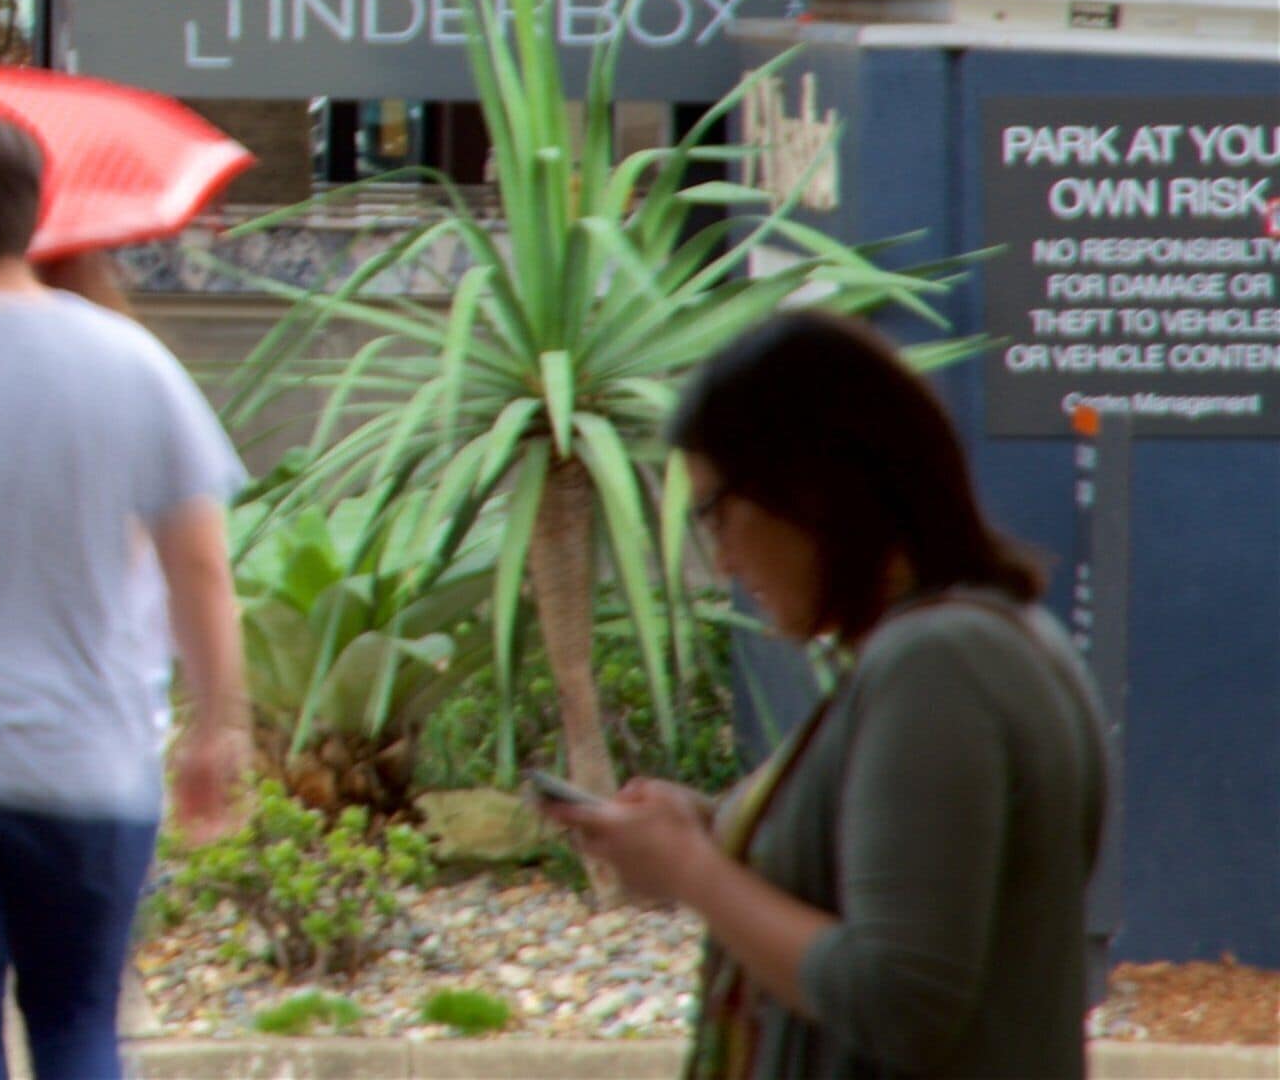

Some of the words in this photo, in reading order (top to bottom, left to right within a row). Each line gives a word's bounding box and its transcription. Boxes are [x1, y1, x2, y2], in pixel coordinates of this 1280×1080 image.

[1002, 126, 1122, 165] PARK
[1126, 126, 1181, 165] AT
[1048, 178, 1158, 219] OWN
[1168, 178, 1272, 218] RISK
[1033, 239, 1077, 265] NO
[1047, 274, 1104, 301] FOR
[1109, 274, 1226, 301] DAMAGE
[1229, 274, 1274, 300] OR
[1030, 310, 1115, 336] THEFT
[1120, 310, 1159, 336] TO
[1006, 345, 1051, 370] OR
[1054, 345, 1166, 370] VEHICLE
[1132, 393, 1262, 420] Management
